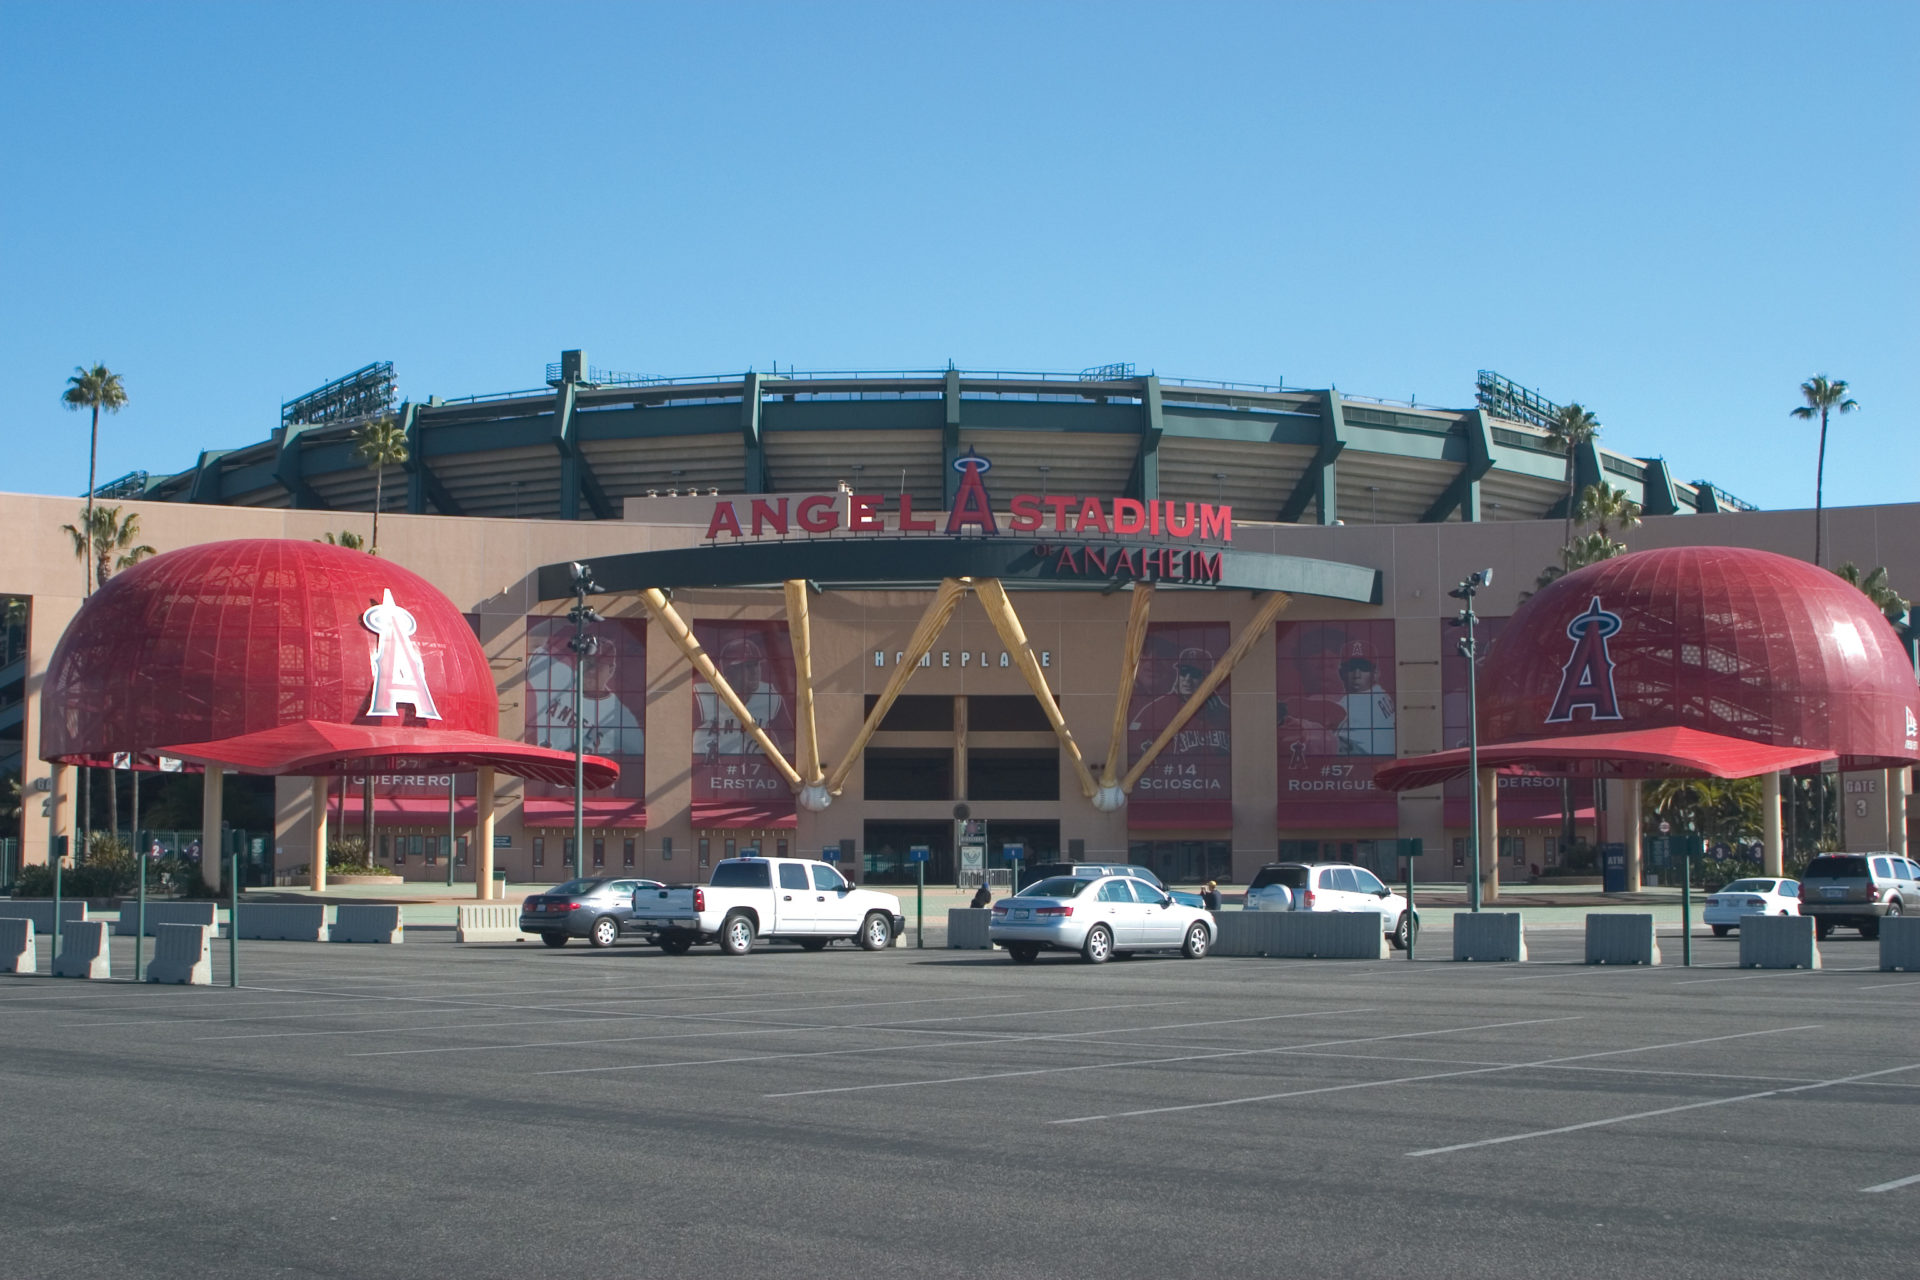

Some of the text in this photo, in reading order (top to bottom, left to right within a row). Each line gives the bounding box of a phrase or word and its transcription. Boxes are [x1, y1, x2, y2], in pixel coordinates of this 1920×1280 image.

[706, 445, 1233, 541] ANGEL A STADIUM
[1056, 546, 1223, 581] ANAHEIM
[875, 652, 1050, 667] HOMEPLAE
[1544, 596, 1624, 723] A
[726, 764, 761, 775] #17
[1163, 764, 1197, 775] #14
[1321, 765, 1354, 776] #57
[710, 777, 777, 789] ERSTAD
[1140, 778, 1221, 790] SCIOSCIA
[1288, 779, 1376, 791] RODRIGUE
[1846, 781, 1875, 793] GATE
[1856, 800, 1867, 817] 3
[152, 844, 160, 856] 2
[191, 845, 199, 857] 2
[1715, 847, 1723, 859] 3
[1754, 847, 1762, 859] 3
[1607, 856, 1624, 865] ATM
